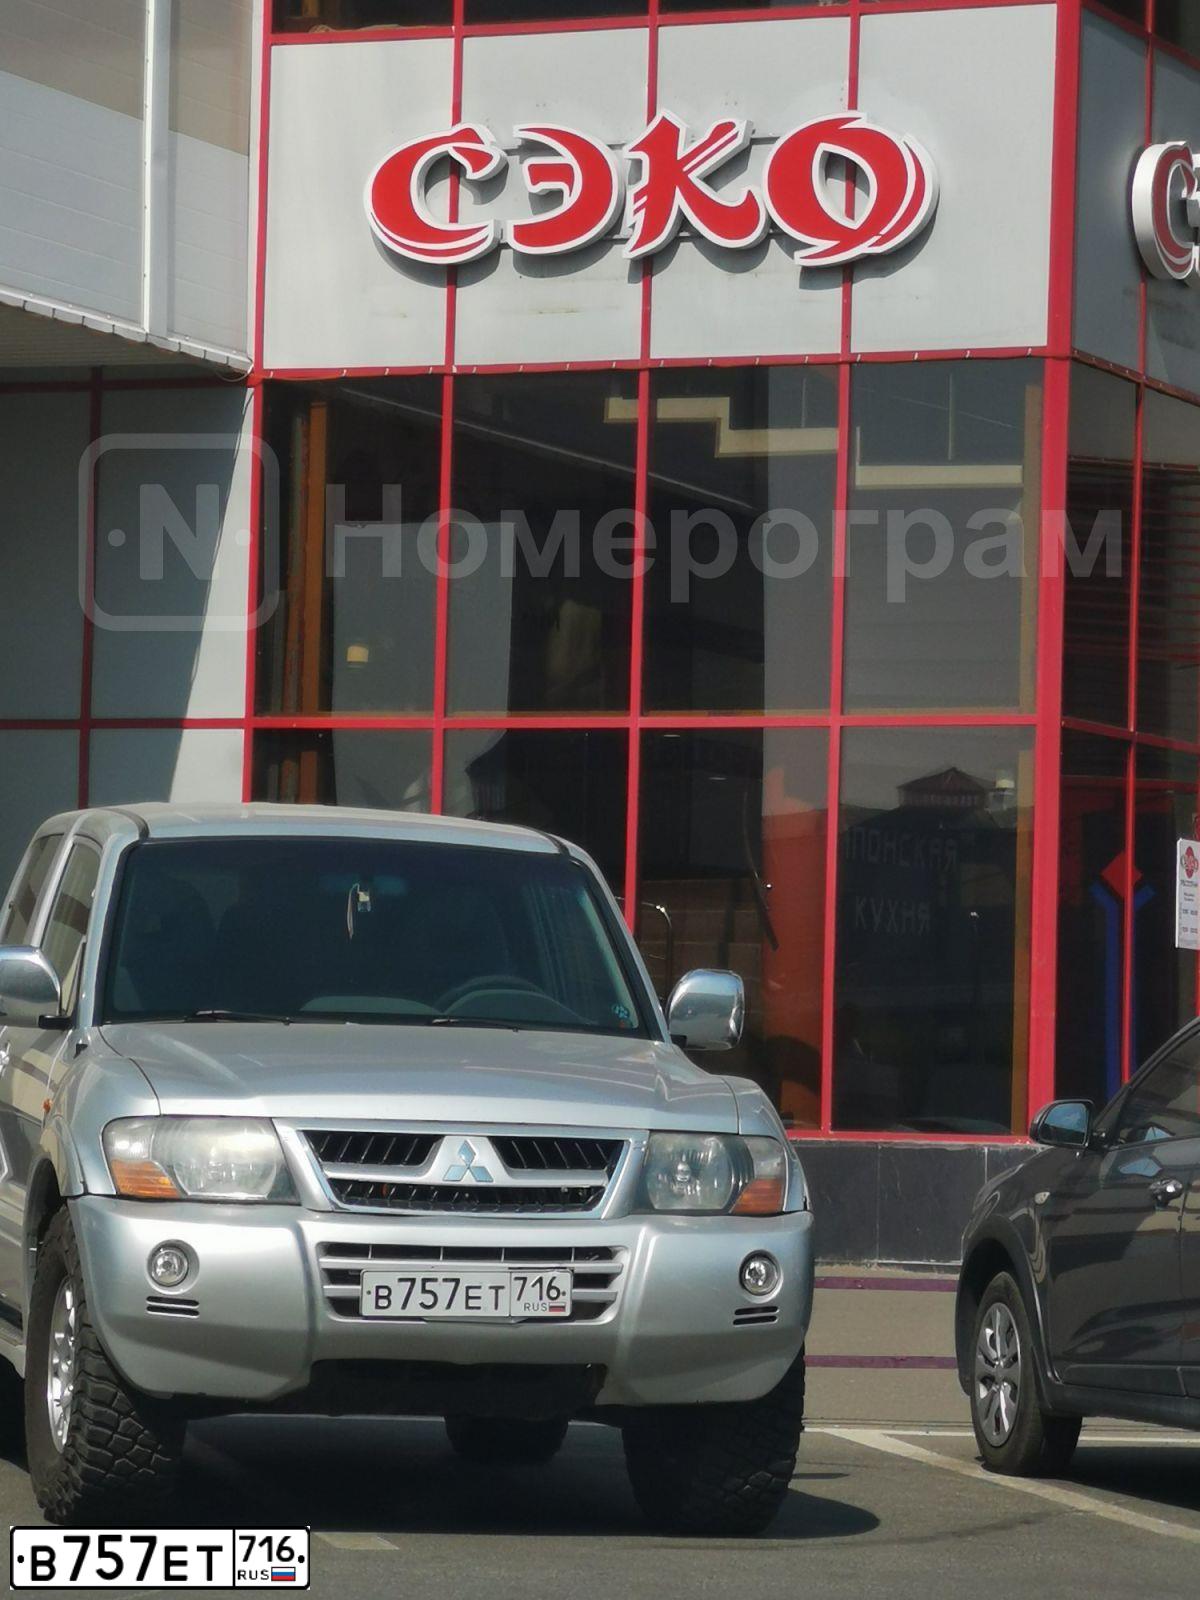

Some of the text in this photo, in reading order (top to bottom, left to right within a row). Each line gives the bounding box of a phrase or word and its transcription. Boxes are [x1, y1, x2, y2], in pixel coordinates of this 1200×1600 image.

[364, 110, 938, 269] СЭКО
[854, 895, 931, 936] КУХНЯ
[374, 1276, 562, 1311] В757ЕТ 716
[523, 1302, 548, 1312] RUS
